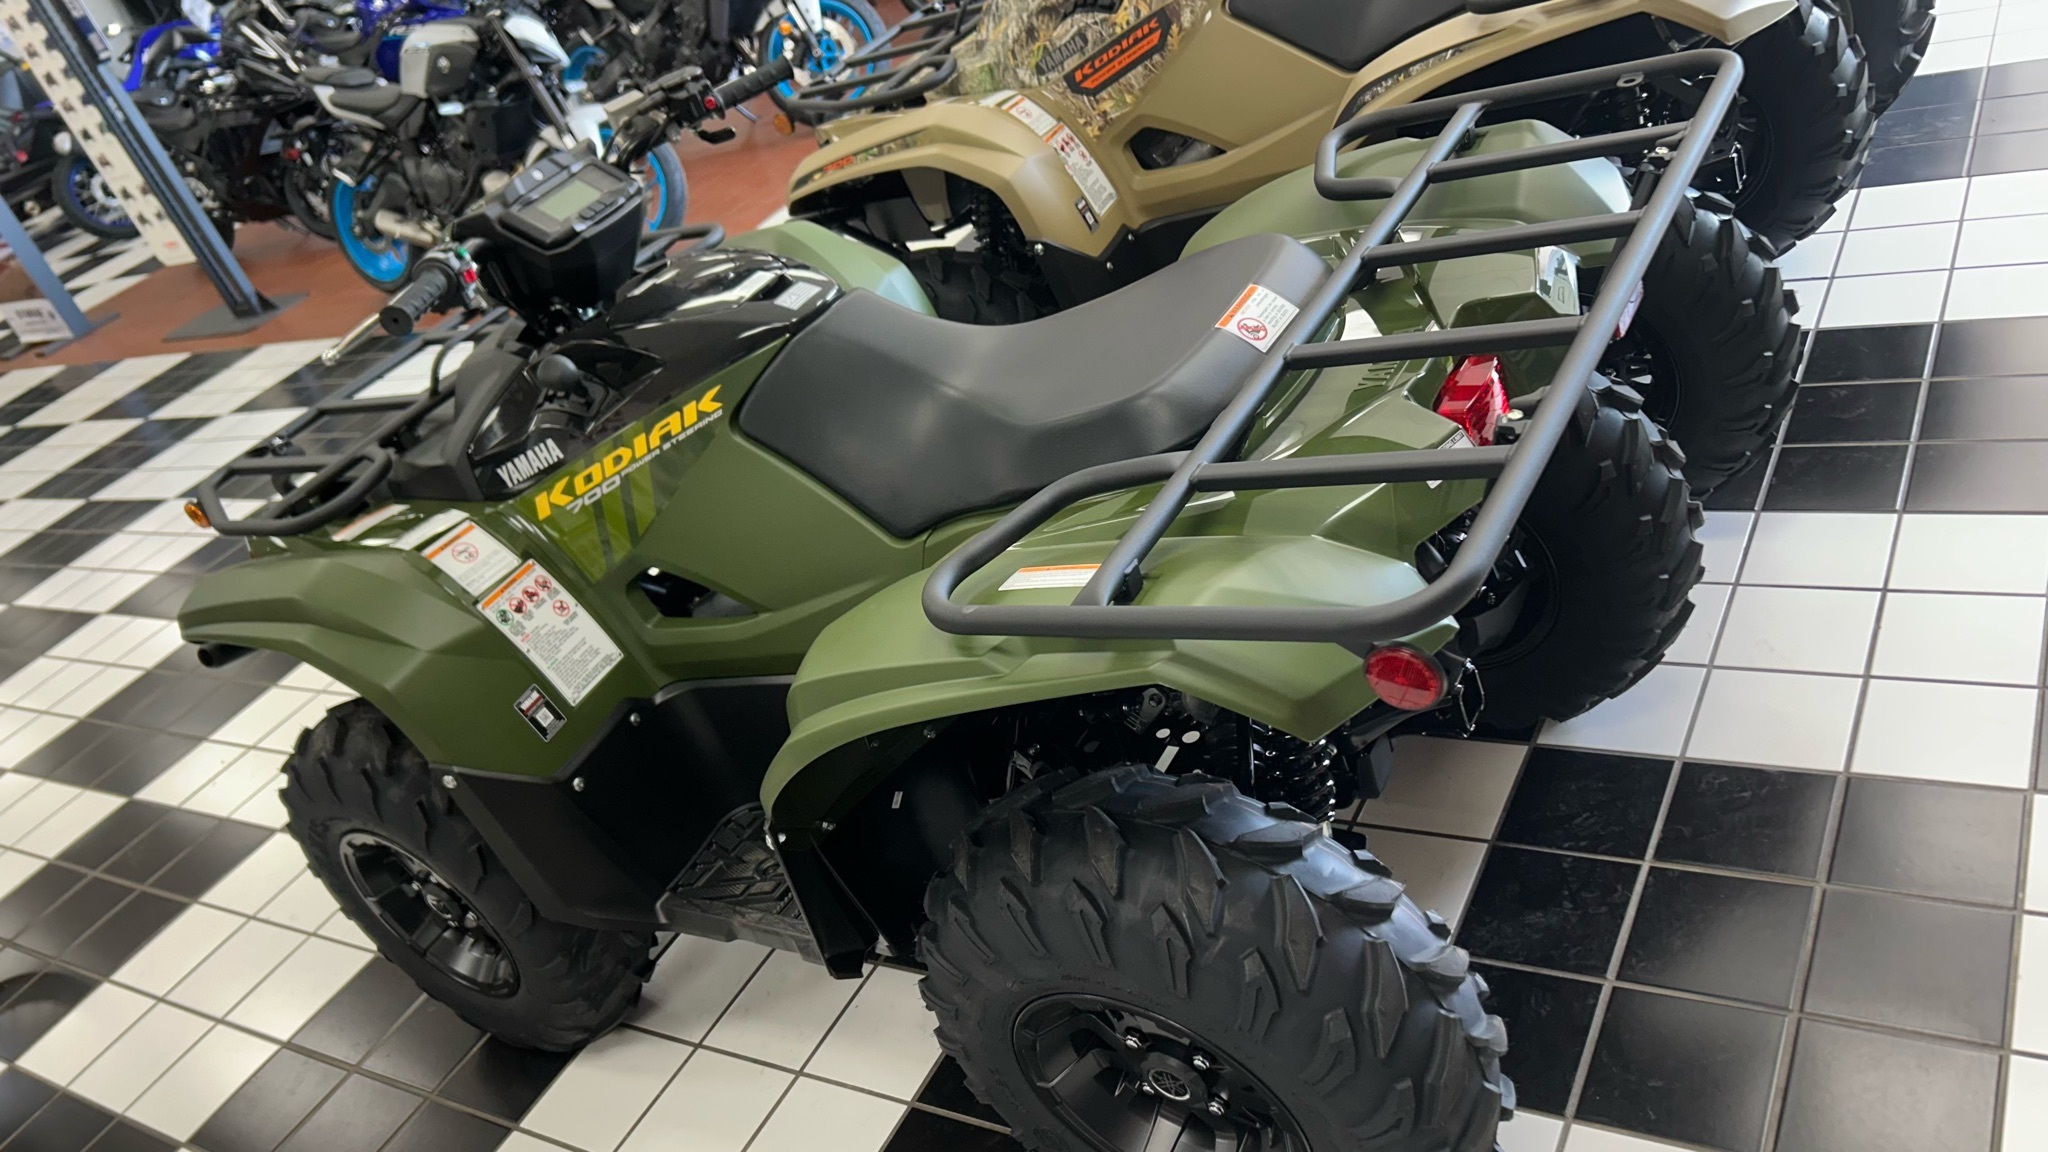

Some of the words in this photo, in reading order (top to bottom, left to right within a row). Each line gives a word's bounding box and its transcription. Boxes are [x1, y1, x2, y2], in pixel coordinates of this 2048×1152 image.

[1040, 34, 1086, 72] YAMAHA
[1075, 17, 1159, 83] KODIAK
[496, 437, 565, 489] YAMAHA
[535, 384, 723, 521] KODIAK
[566, 473, 622, 515] 700
[620, 448, 661, 478] POWER
[662, 408, 723, 451] STEERING
